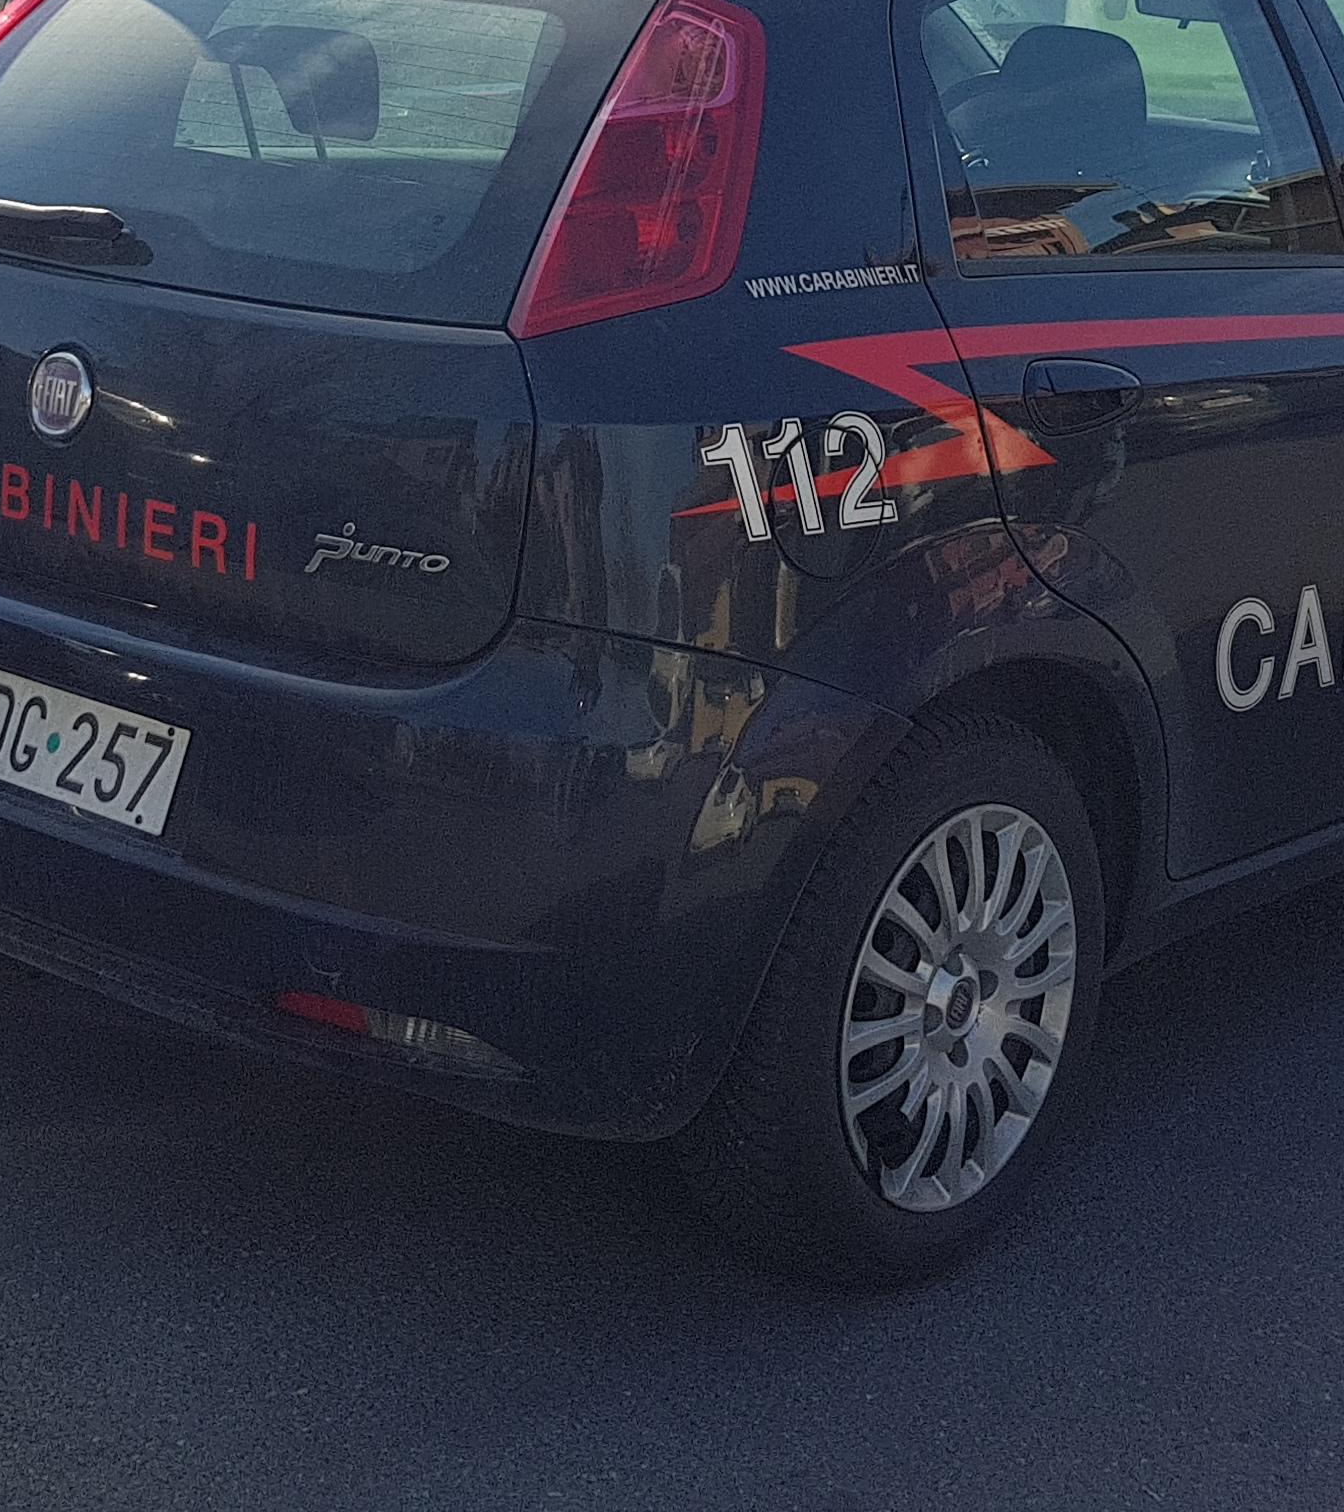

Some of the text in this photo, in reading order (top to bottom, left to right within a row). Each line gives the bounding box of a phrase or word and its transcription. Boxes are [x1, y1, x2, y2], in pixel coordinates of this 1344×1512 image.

[745, 264, 920, 299] WWW.CARABINIERI.IT
[41, 375, 78, 417] FIAT
[701, 411, 899, 543] 112
[55, 711, 175, 813] 257
